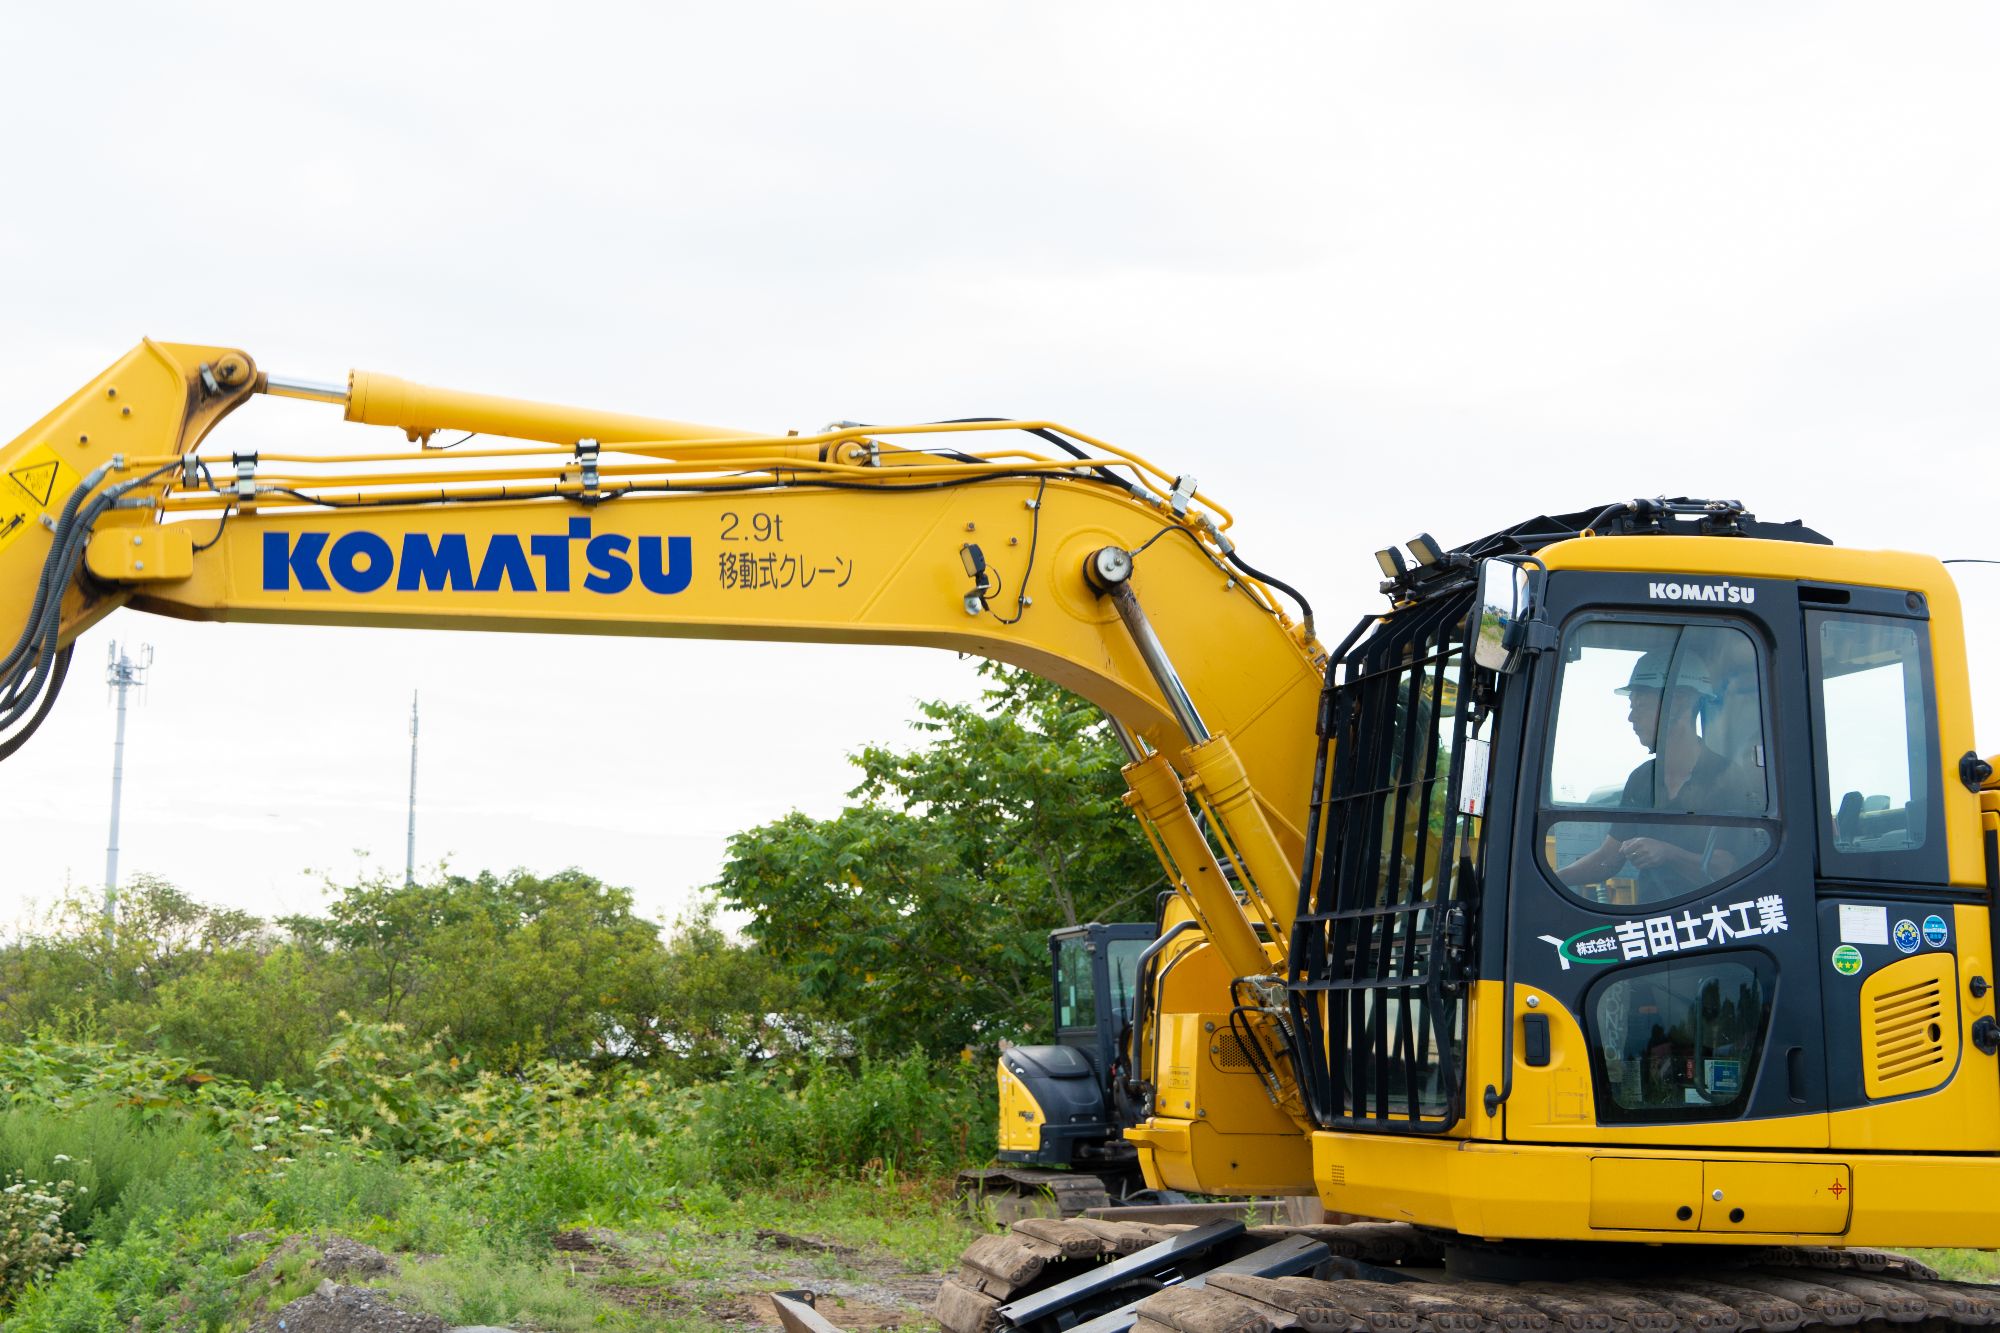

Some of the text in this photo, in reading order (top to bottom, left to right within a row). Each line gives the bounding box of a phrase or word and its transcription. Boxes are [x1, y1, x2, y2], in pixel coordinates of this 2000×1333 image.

[719, 511, 784, 542] 2.9t
[263, 516, 692, 595] KOMATSU
[718, 551, 853, 590] 移動式クレーン
[1648, 581, 1755, 604] KOMATSU
